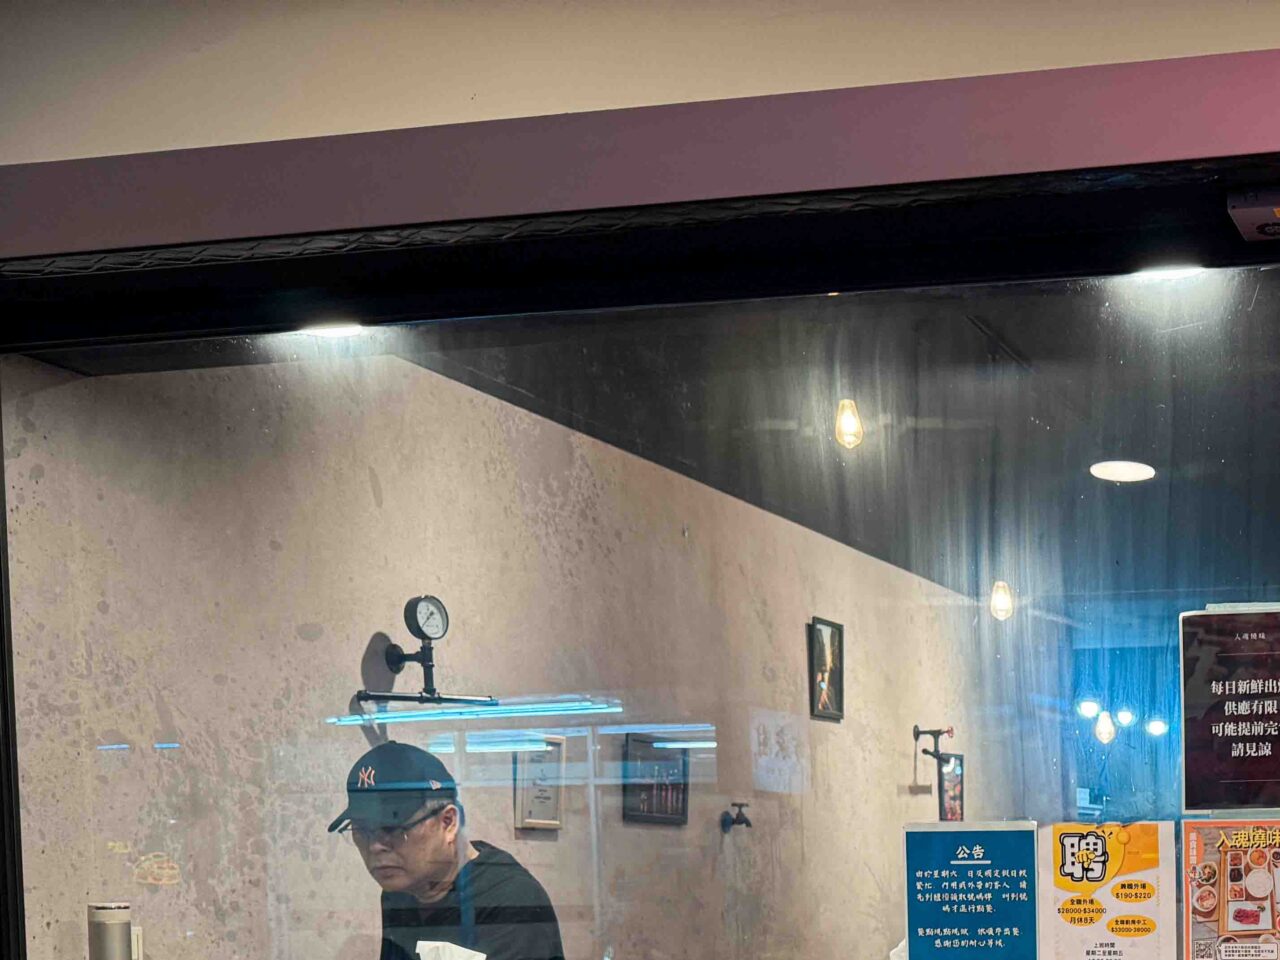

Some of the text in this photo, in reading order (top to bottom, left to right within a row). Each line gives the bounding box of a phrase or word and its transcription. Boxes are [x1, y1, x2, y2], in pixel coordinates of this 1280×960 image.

[1224, 700, 1278, 715] 供應有限
[1231, 742, 1272, 757] 請見諒
[956, 844, 985, 859] 公告
[1060, 831, 1109, 882] 聘
